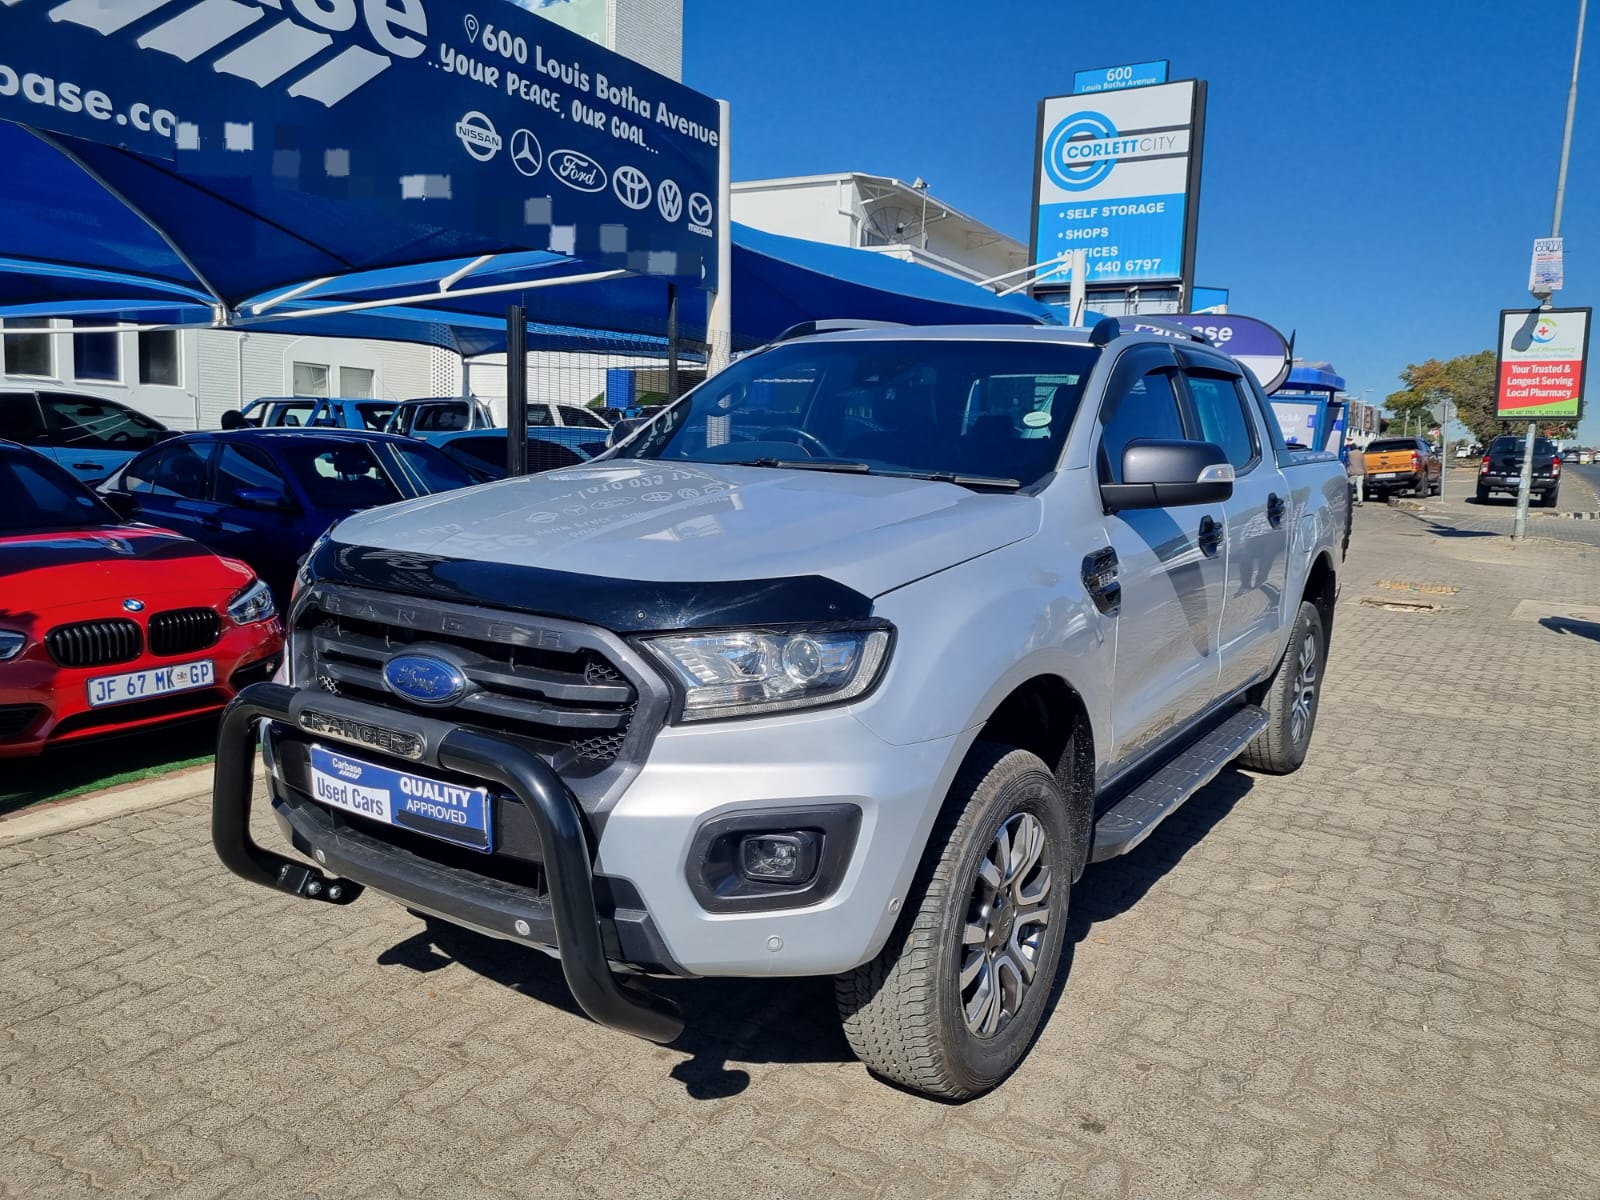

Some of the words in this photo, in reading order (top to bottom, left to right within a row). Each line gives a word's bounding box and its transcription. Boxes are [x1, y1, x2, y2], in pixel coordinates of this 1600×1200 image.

[1106, 66, 1133, 82] 600
[482, 24, 528, 64] 600
[536, 45, 590, 92] Louis
[596, 73, 651, 119] Botha
[656, 104, 719, 147] Avenue
[1081, 84, 1102, 92] Louis
[1103, 81, 1126, 89] Botha
[1127, 77, 1157, 86] Avenue
[507, 71, 566, 119] PEACE,
[571, 99, 606, 131] OUR
[611, 116, 659, 154] GOAL...
[458, 125, 500, 147] NISSAN
[559, 154, 598, 186] Ford
[1066, 207, 1098, 220] SELF
[1101, 202, 1165, 217] STORAGE
[1065, 227, 1109, 240] SHOPS
[1094, 260, 1121, 273] 440
[1125, 258, 1161, 271] 6797
[1511, 364, 1530, 374] Your
[1531, 364, 1562, 374] Trusted
[1563, 364, 1571, 373] &
[1507, 376, 1539, 387] Longest
[1541, 376, 1574, 387] Serving
[1506, 388, 1528, 397] Local
[1530, 388, 1572, 398] Pharmacy
[96, 679, 117, 702] JF
[127, 674, 146, 696] 67
[154, 668, 176, 691] MK
[189, 663, 210, 684] GP
[332, 757, 363, 775] Carbase
[317, 776, 348, 804] Used
[352, 788, 384, 816] Cars
[400, 776, 471, 808] QUALITY
[406, 799, 468, 825] APPROVED
